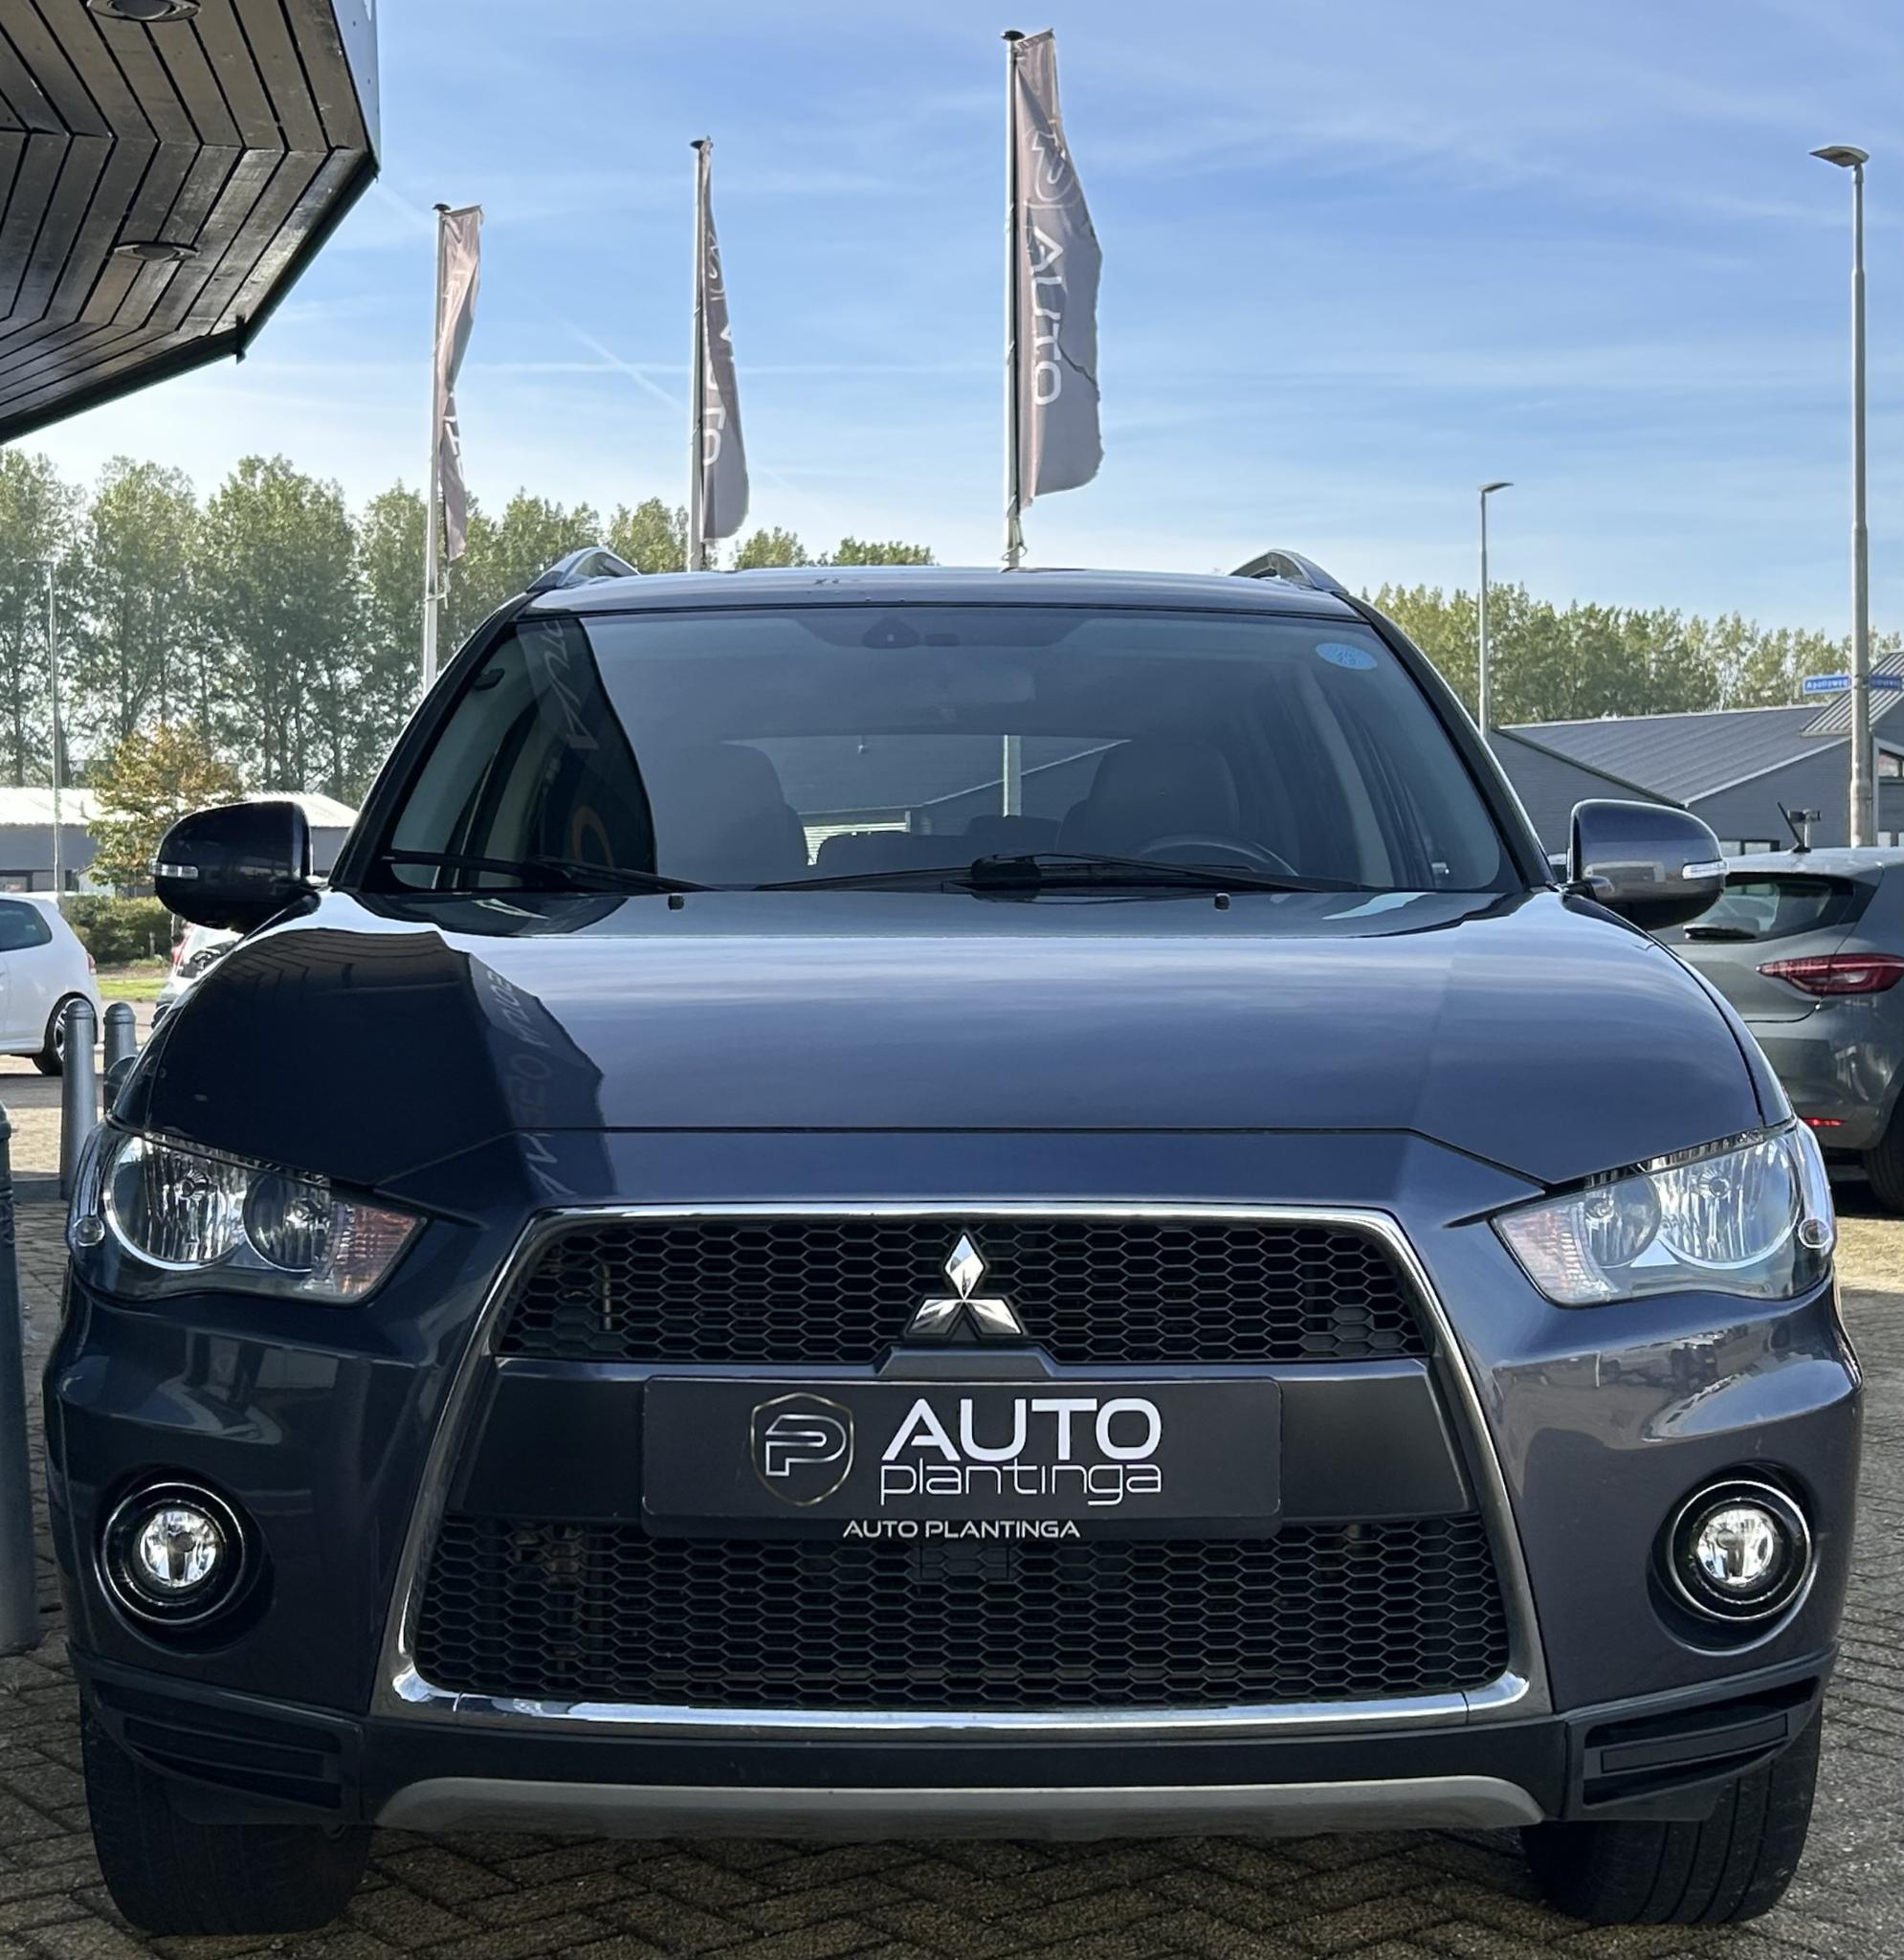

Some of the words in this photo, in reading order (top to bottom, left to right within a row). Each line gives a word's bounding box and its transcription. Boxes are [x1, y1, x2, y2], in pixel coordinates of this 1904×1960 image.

[881, 1397, 1162, 1461] AUTO
[880, 1457, 1162, 1506] plantinga
[842, 1520, 919, 1539] AUTO
[924, 1520, 1082, 1539] PLANTINGA
